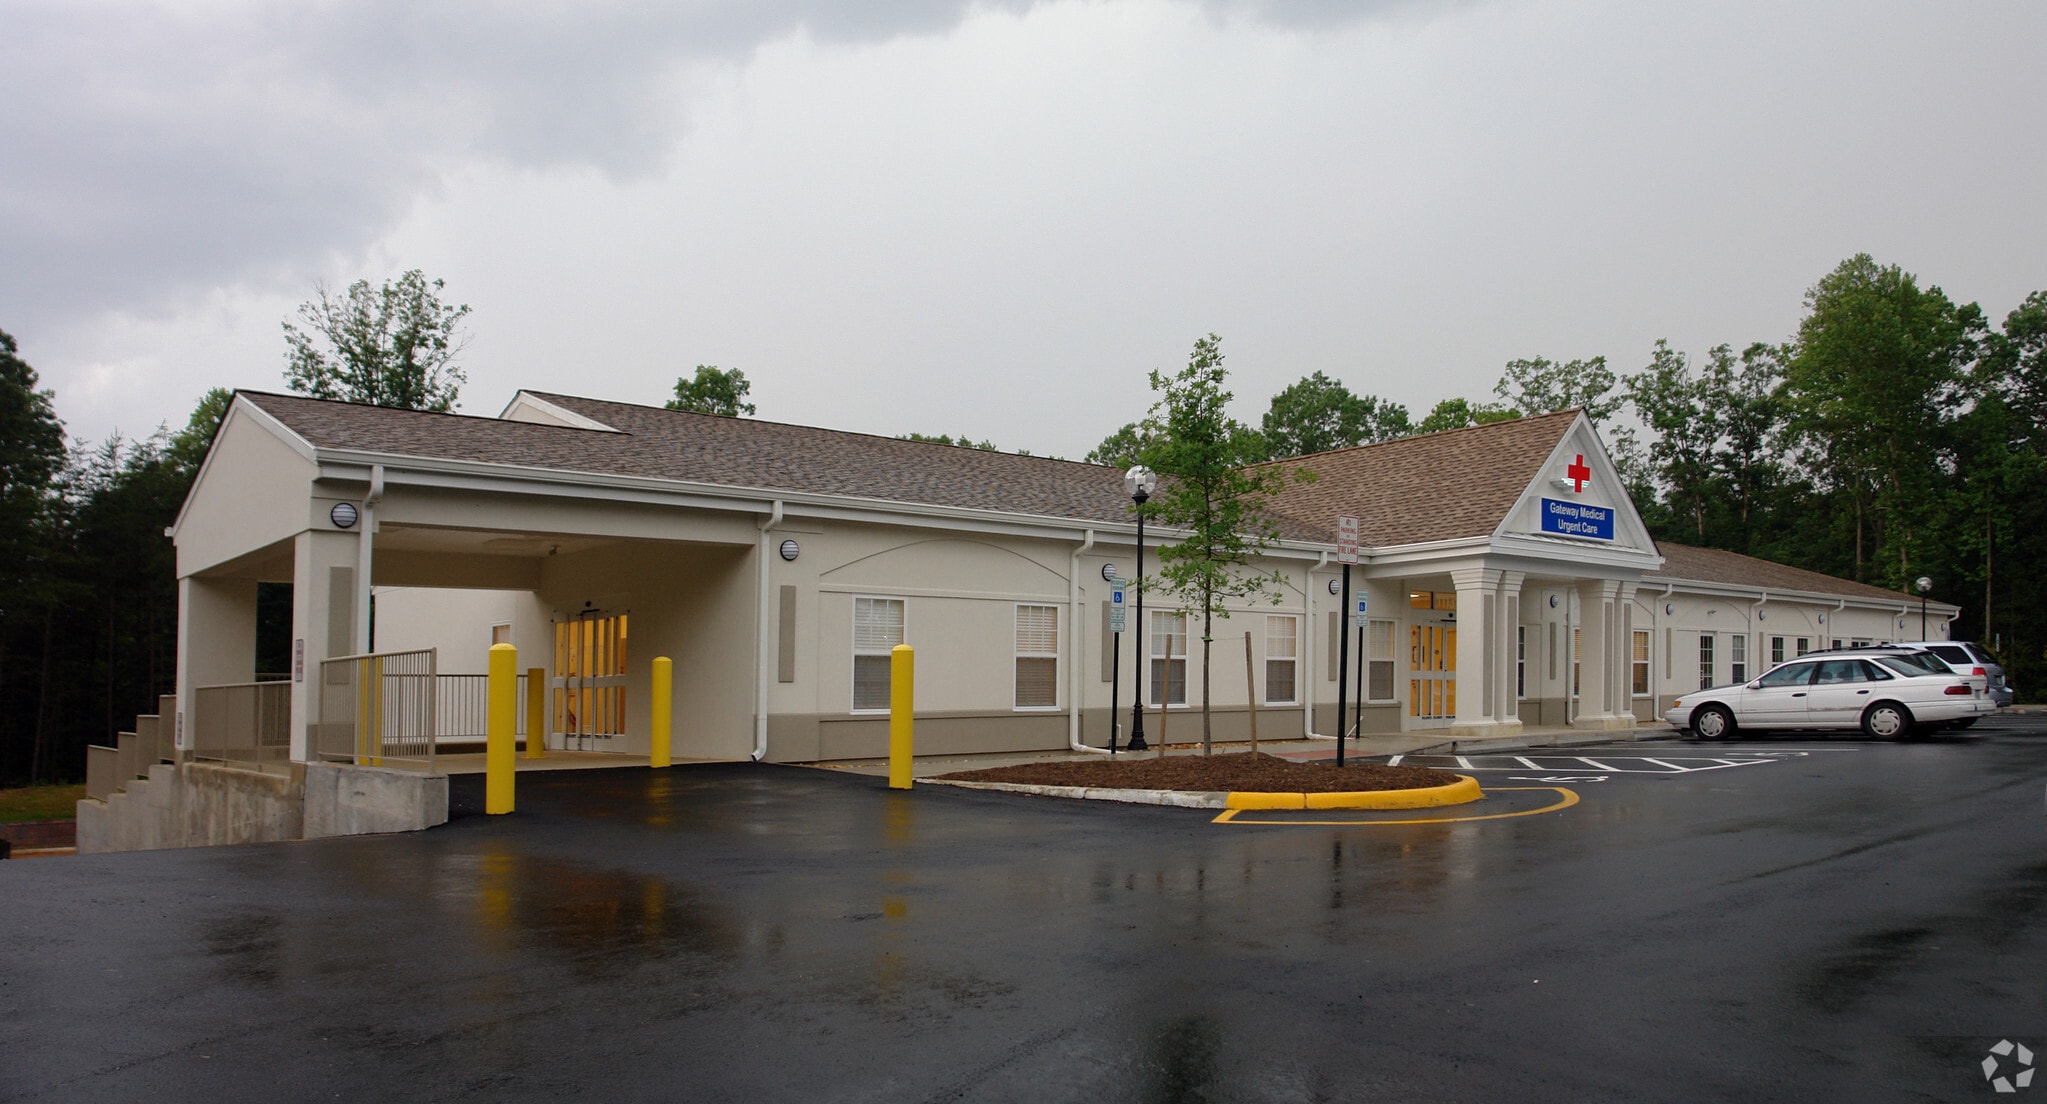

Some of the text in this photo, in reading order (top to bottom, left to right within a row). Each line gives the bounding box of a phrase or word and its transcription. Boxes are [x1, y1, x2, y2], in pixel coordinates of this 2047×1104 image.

[1550, 502, 1605, 520] Gateway Medical
[1558, 518, 1598, 534] Urgent Care
